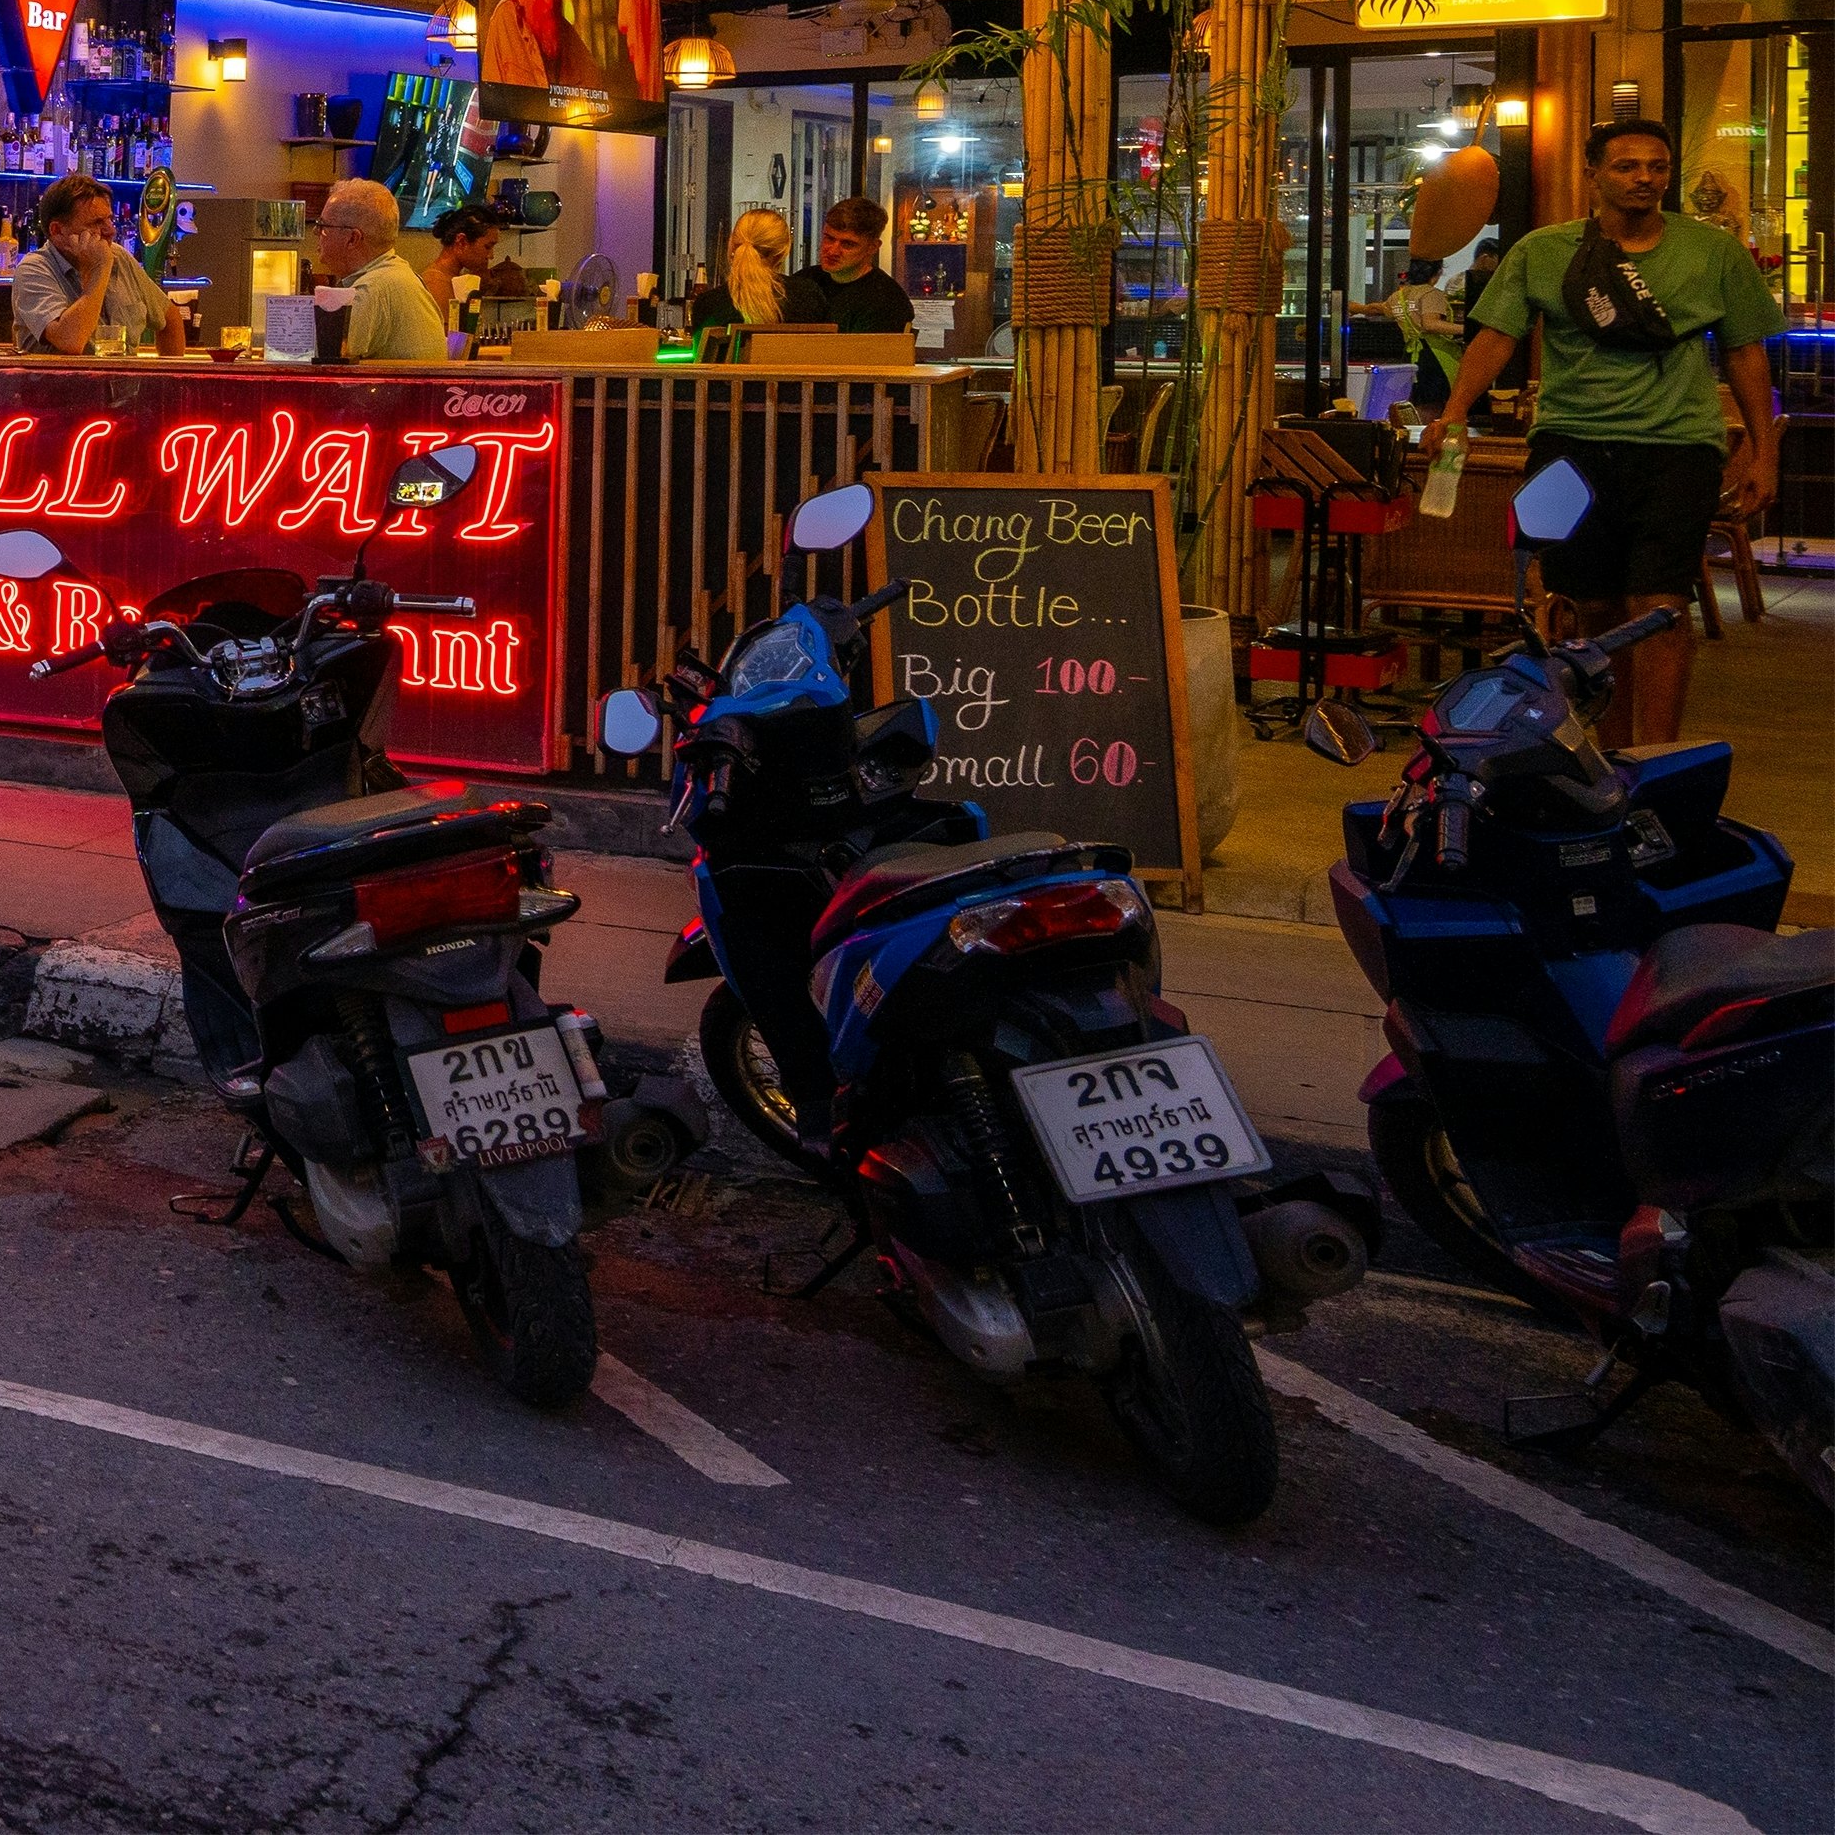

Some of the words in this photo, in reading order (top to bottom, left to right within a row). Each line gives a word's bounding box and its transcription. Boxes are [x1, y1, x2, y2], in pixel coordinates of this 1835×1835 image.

[27, 1, 69, 33] Bar
[160, 410, 555, 543] WAIT
[893, 498, 1041, 582] Chang
[1038, 498, 1153, 546] Beer
[898, 653, 1010, 731] Big
[425, 937, 476, 956] HONDA
[443, 1070, 561, 1122] สุราษฎร์ธานี
[1067, 1055, 1180, 1109] 2กจ
[454, 1107, 571, 1159] 6289
[1071, 1096, 1212, 1150] สุราษฎร์ธานี
[476, 1136, 573, 1167] LIVERPOOL
[1092, 1132, 1230, 1188] 4939
